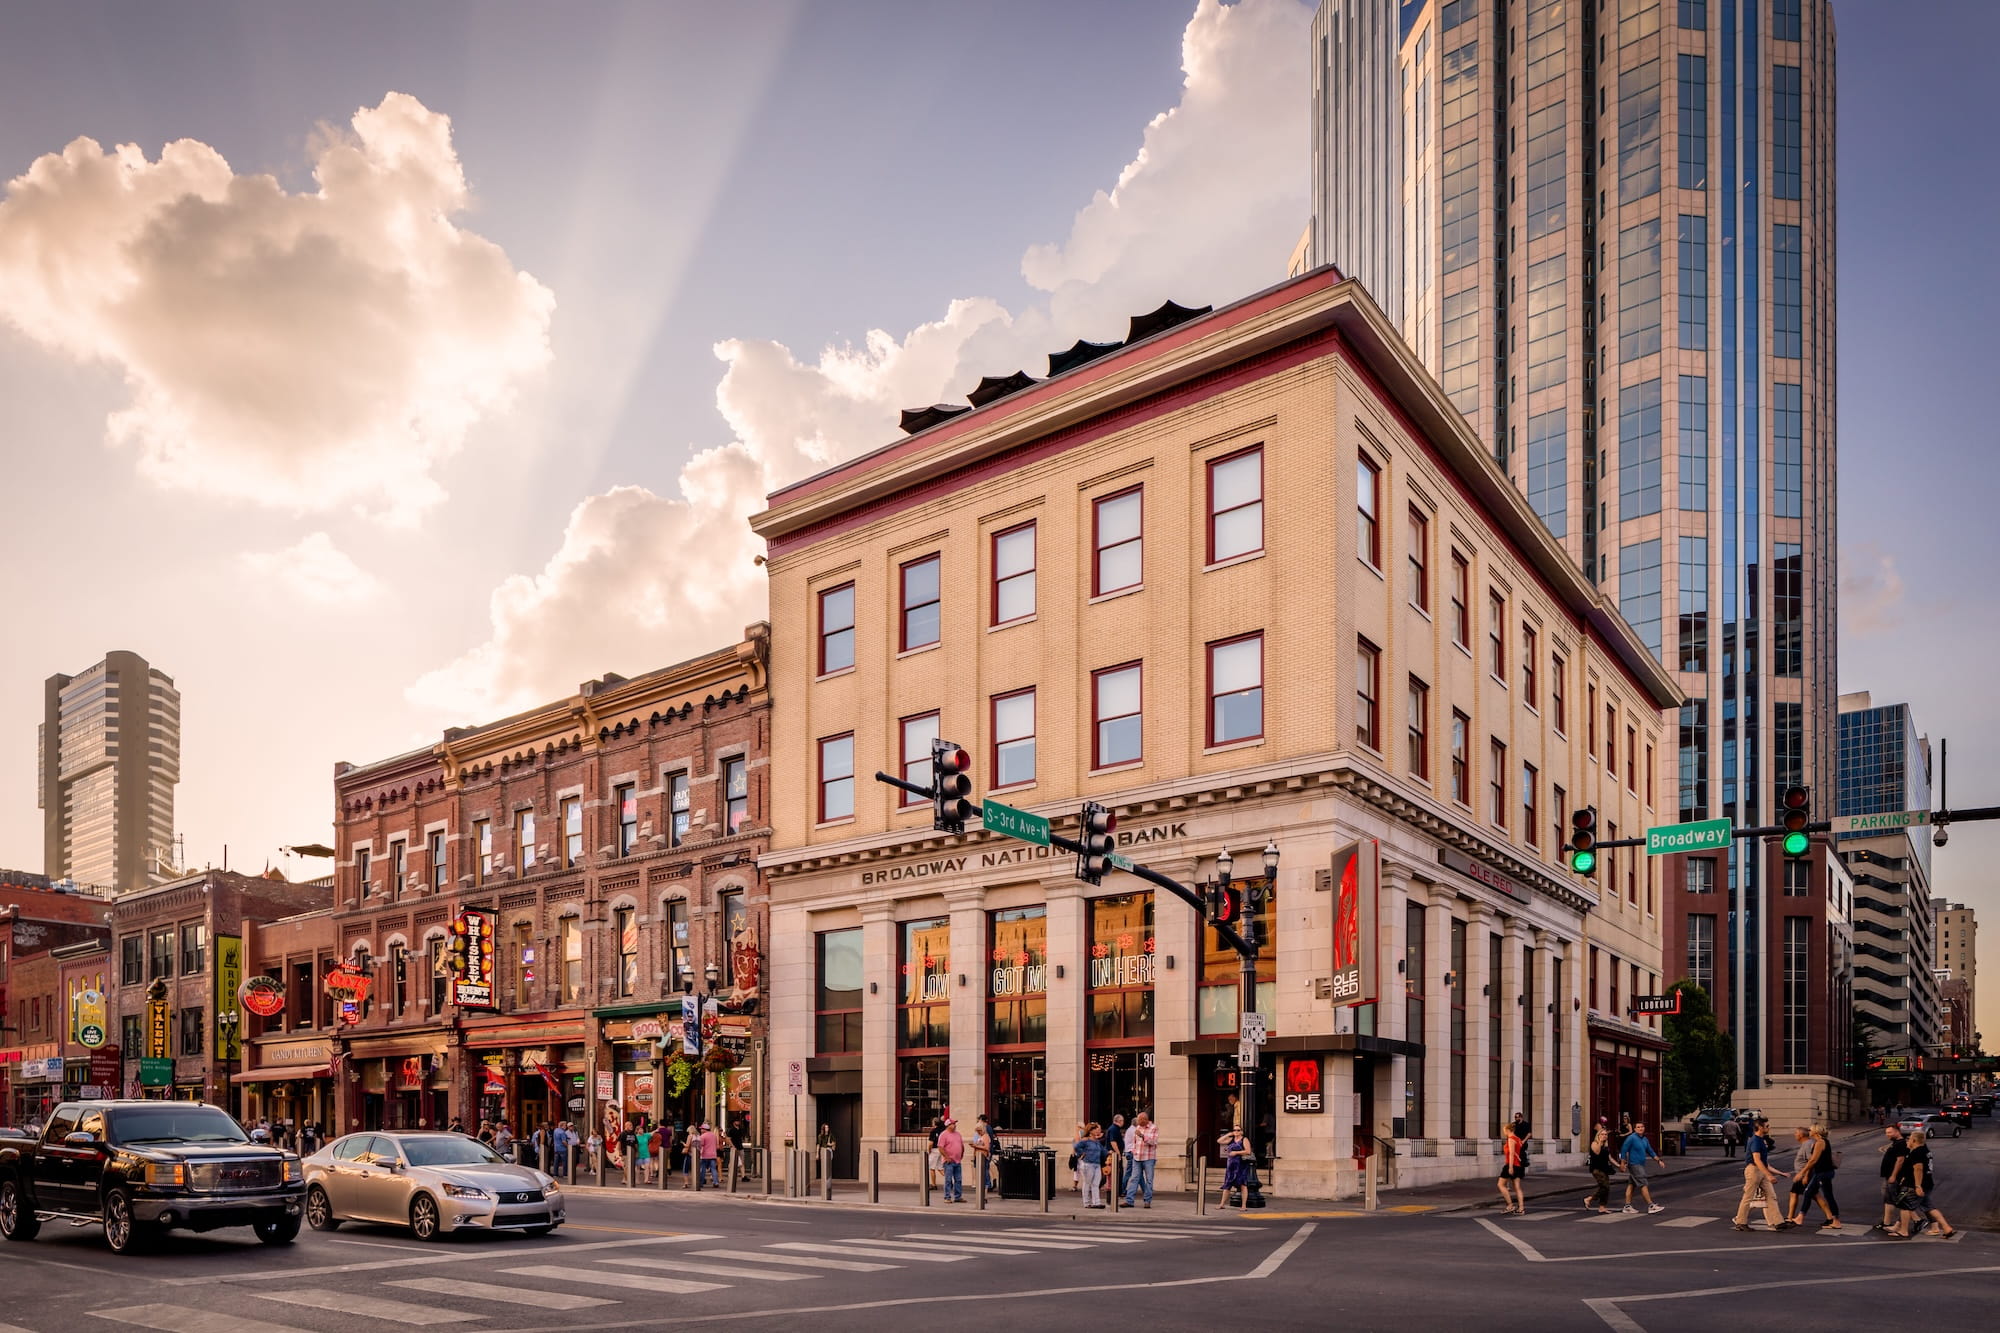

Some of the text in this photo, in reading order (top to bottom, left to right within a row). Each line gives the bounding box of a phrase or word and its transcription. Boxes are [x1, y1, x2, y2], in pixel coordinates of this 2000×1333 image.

[1851, 813, 1911, 830] PARKING
[1650, 828, 1726, 849] Broadway
[862, 823, 1187, 885] BROADWAY NATION BANK
[1469, 863, 1513, 894] OLE RED
[467, 915, 481, 985] WHISKEY
[327, 970, 372, 988] CRAZY
[920, 975, 950, 1000] LOV
[993, 966, 1024, 996] GOT
[1091, 958, 1110, 988] IN
[1333, 970, 1358, 986] OLE
[330, 987, 367, 1002] TOWN
[1333, 982, 1358, 998] RED
[1640, 1000, 1674, 1010] LOOKOUT
[635, 1023, 660, 1038] BOOT
[1243, 1028, 1252, 1039] OK
[271, 1046, 322, 1060] CANDY KITCHEN
[598, 1087, 613, 1096] FREE
[1285, 1094, 1321, 1102] OLE
[1285, 1101, 1321, 1110] RED
